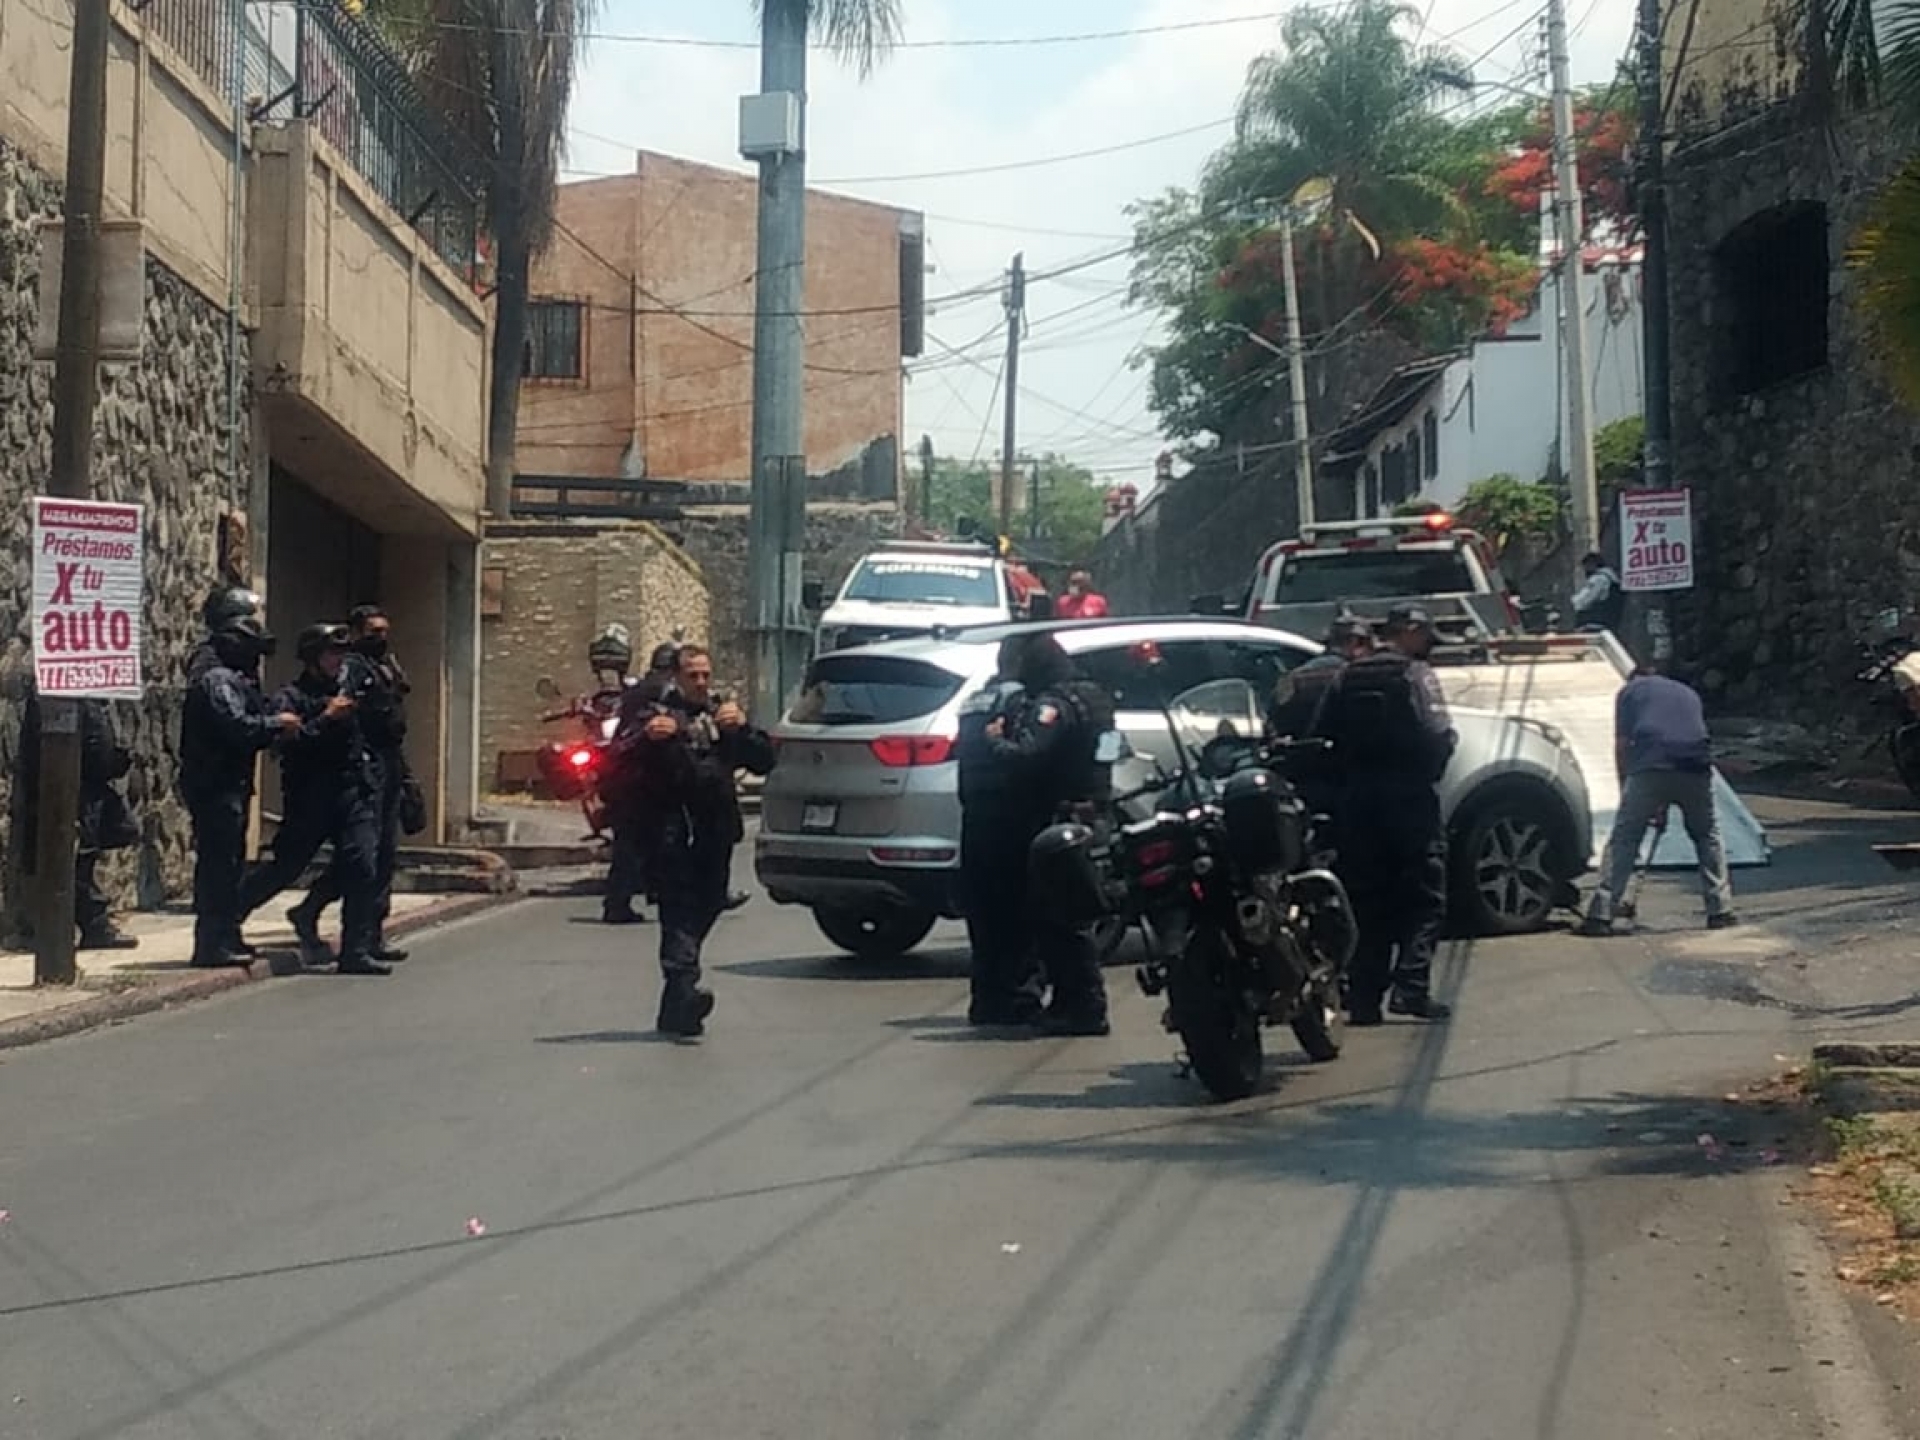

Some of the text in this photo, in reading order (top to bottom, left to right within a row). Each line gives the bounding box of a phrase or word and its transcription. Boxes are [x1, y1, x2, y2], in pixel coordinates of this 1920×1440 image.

[43, 532, 134, 560] Préstamos
[1634, 521, 1650, 543] X
[1628, 538, 1686, 568] auto
[49, 562, 104, 605] X tu
[43, 600, 131, 653] auto
